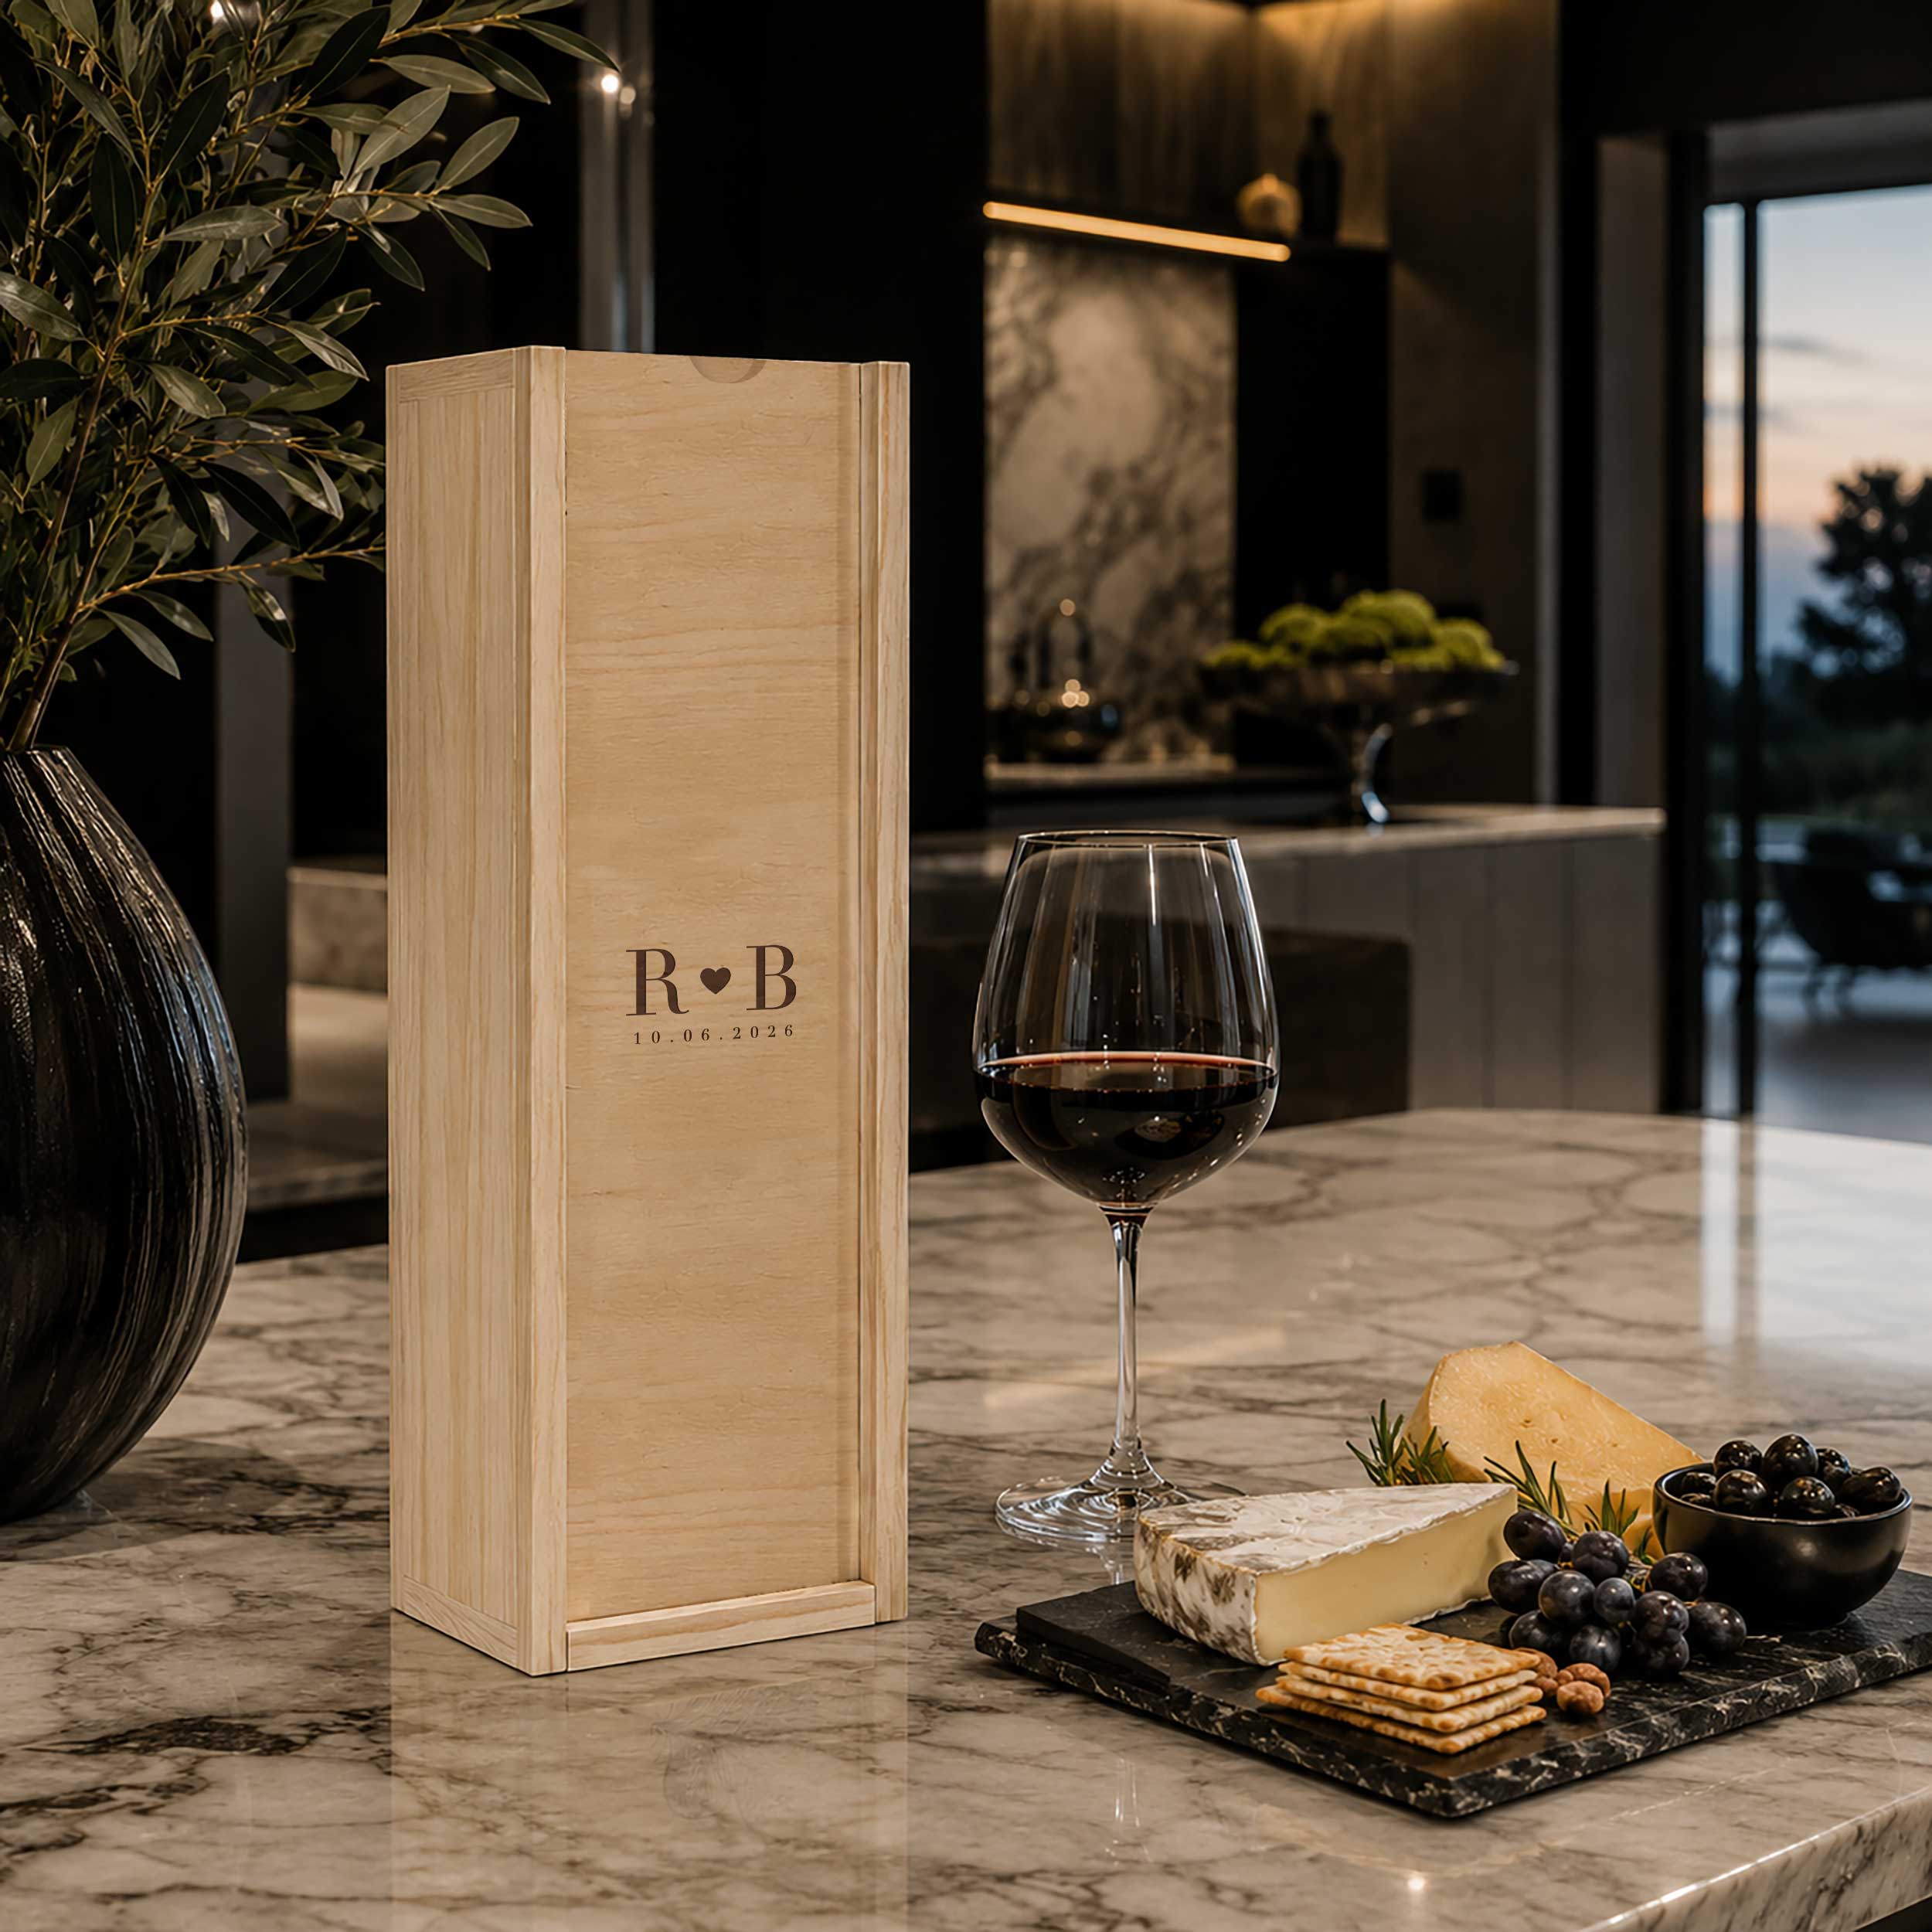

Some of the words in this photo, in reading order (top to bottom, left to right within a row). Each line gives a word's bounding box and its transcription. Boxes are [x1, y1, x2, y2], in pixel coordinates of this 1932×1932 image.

[626, 948, 689, 1016] R
[746, 944, 797, 1011] B
[634, 1024, 794, 1045] 10.06.2026
